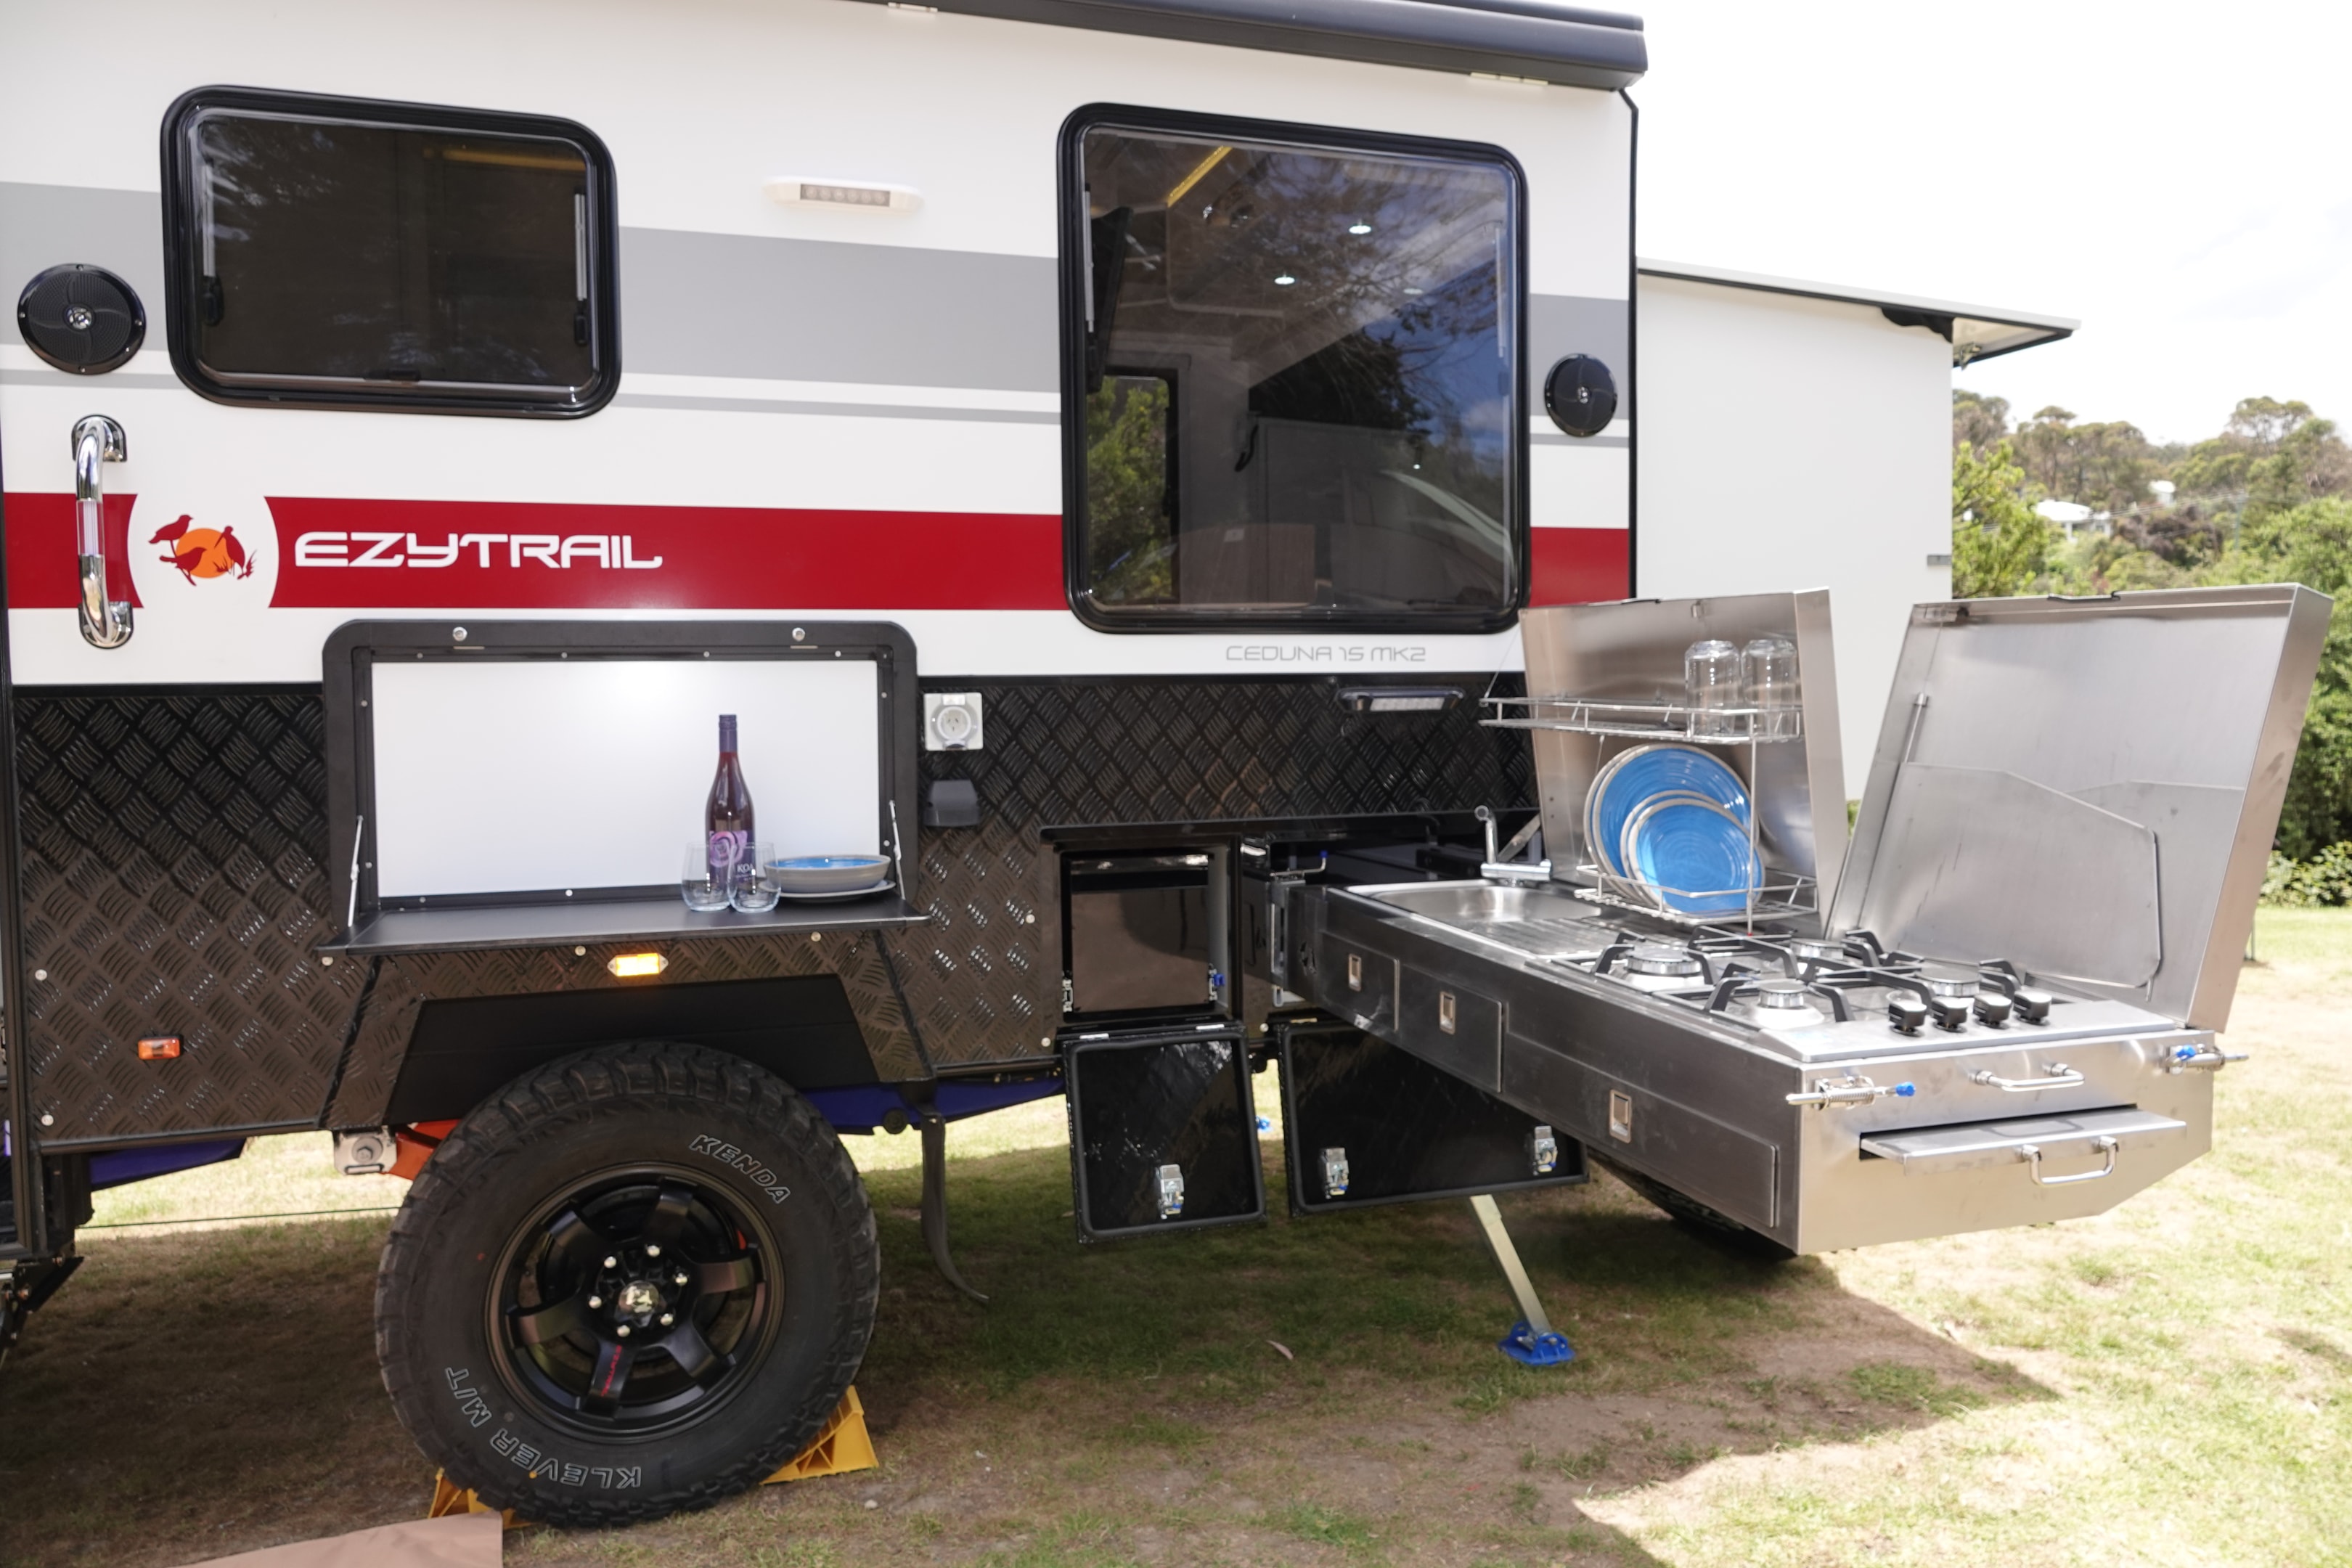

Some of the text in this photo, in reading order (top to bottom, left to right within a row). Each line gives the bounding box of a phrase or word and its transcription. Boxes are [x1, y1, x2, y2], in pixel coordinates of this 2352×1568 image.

[295, 531, 663, 569] EZYTRAIL
[1225, 645, 1332, 661] CEDUNA
[1339, 646, 1365, 661] 15
[688, 1133, 792, 1204] KENDA
[444, 1366, 642, 1490] KLEVER M/T
